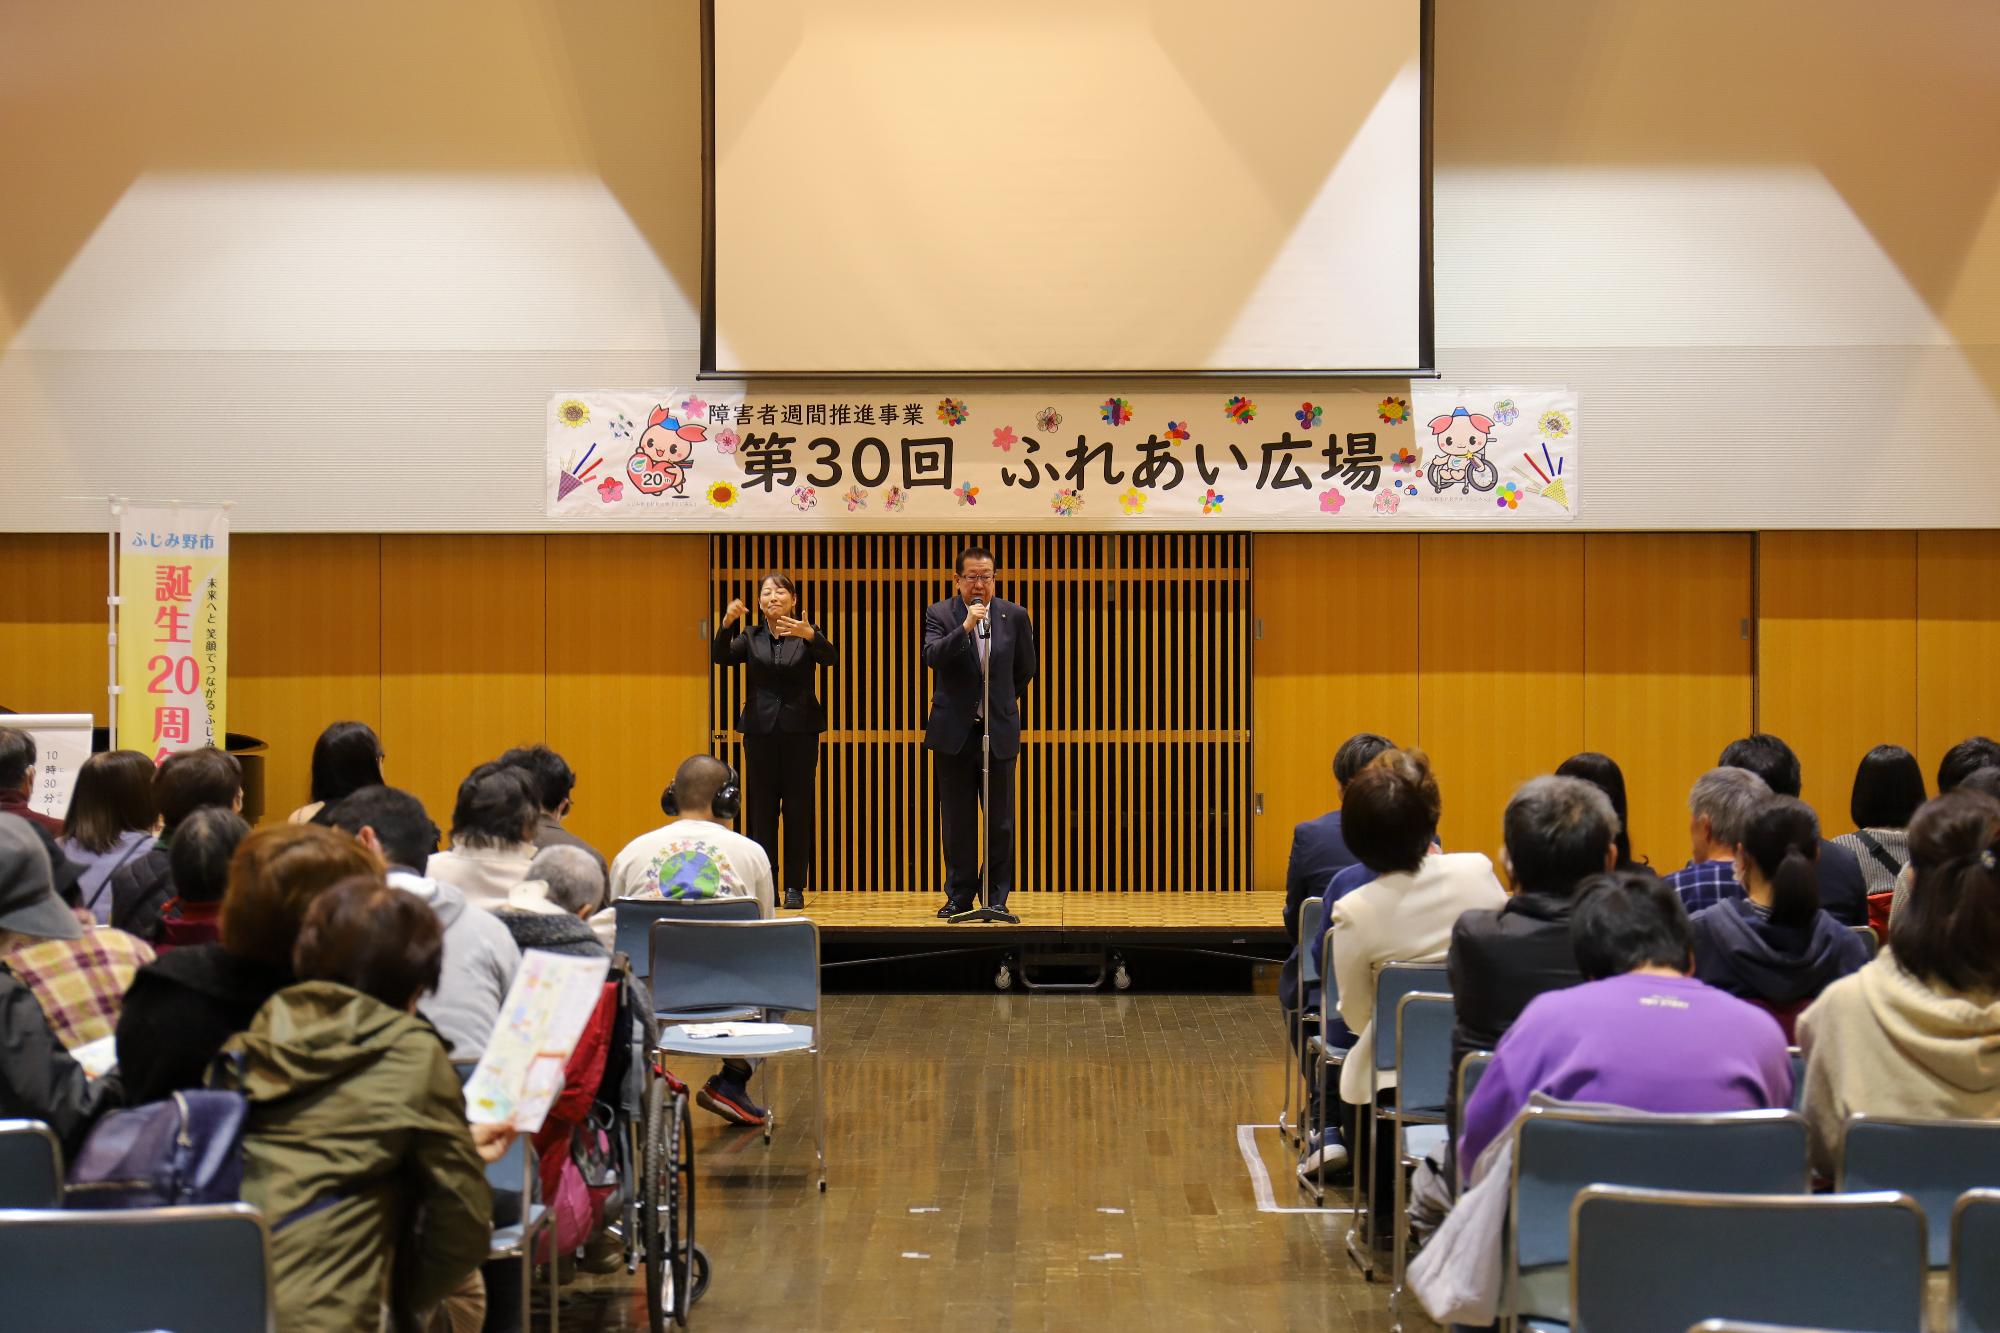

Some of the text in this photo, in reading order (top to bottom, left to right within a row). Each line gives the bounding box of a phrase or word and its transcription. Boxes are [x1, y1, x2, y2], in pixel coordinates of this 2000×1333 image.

[708, 403, 925, 426] 障害者週間推進事業
[740, 432, 954, 493] 第30回
[1001, 432, 1384, 491] ふれあい広場
[132, 532, 215, 550] ふじみ野市
